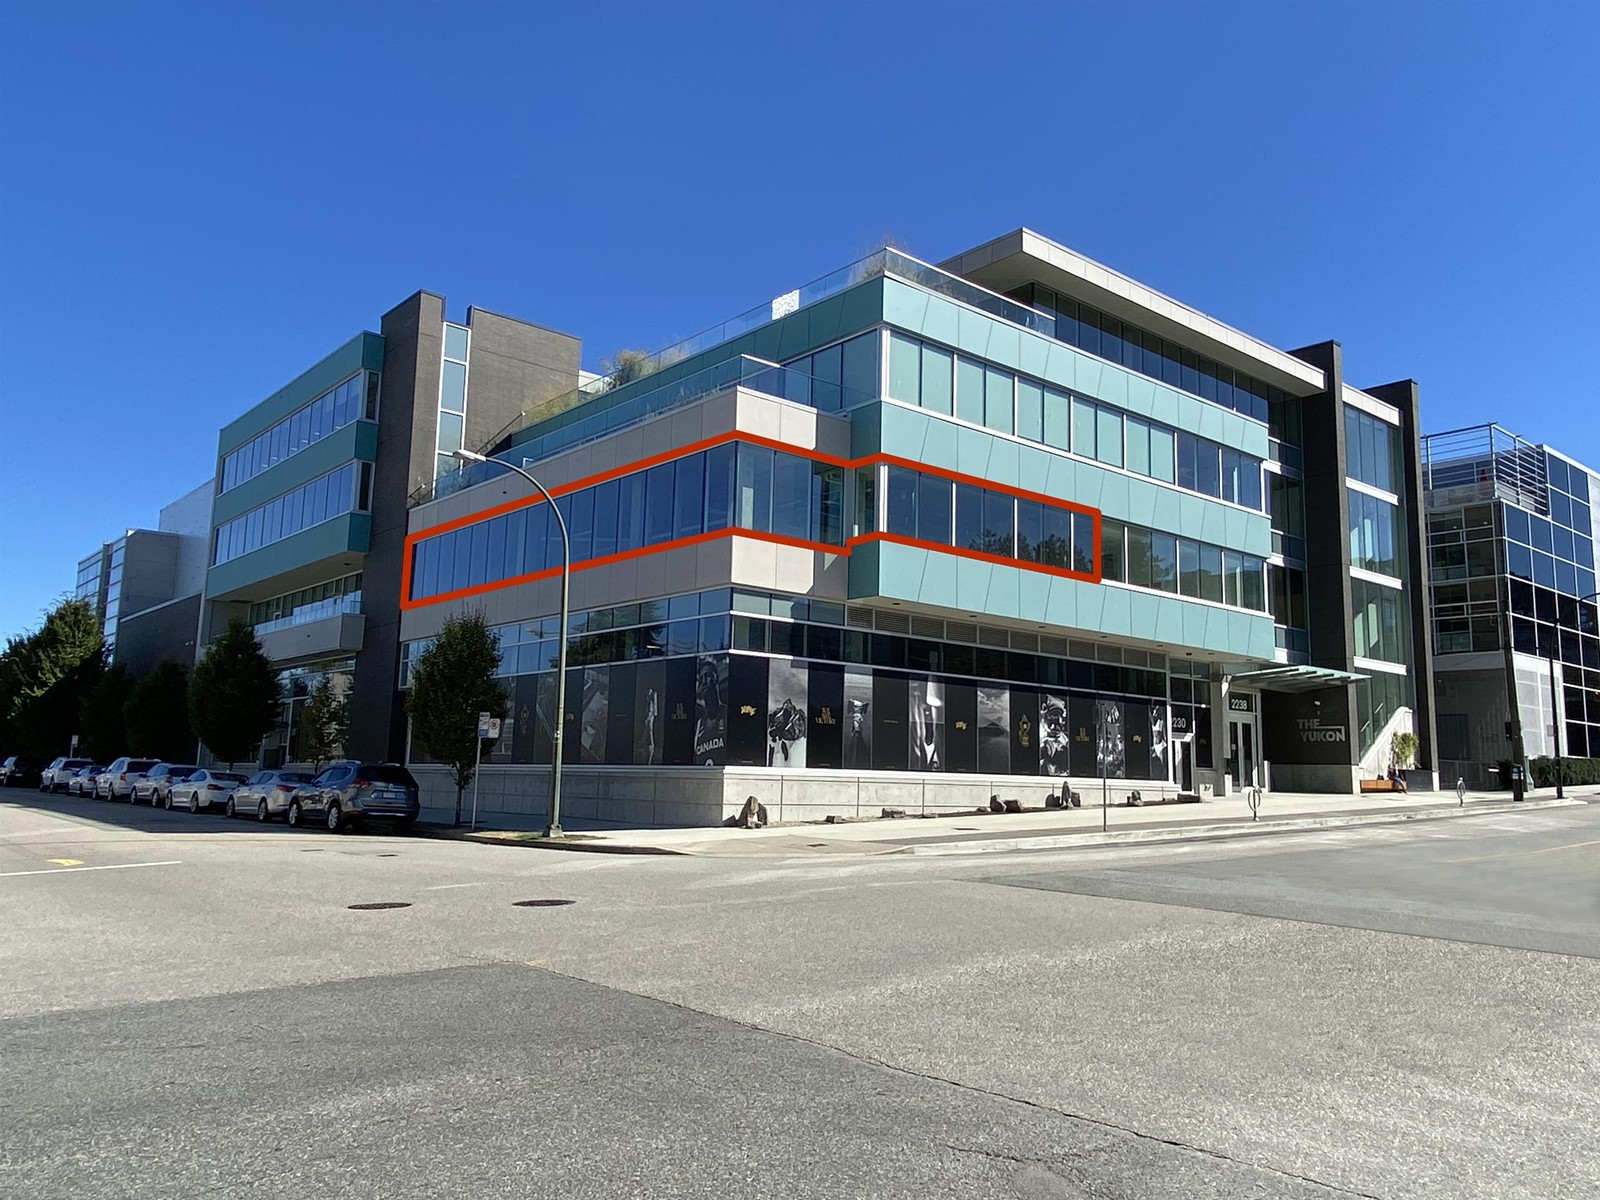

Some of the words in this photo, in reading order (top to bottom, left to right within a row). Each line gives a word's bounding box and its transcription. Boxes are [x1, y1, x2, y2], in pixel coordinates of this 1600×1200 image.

[1231, 699, 1248, 710] 2238
[1296, 718, 1321, 730] THE
[1300, 730, 1346, 742] YUKON
[696, 737, 725, 755] CANADA
